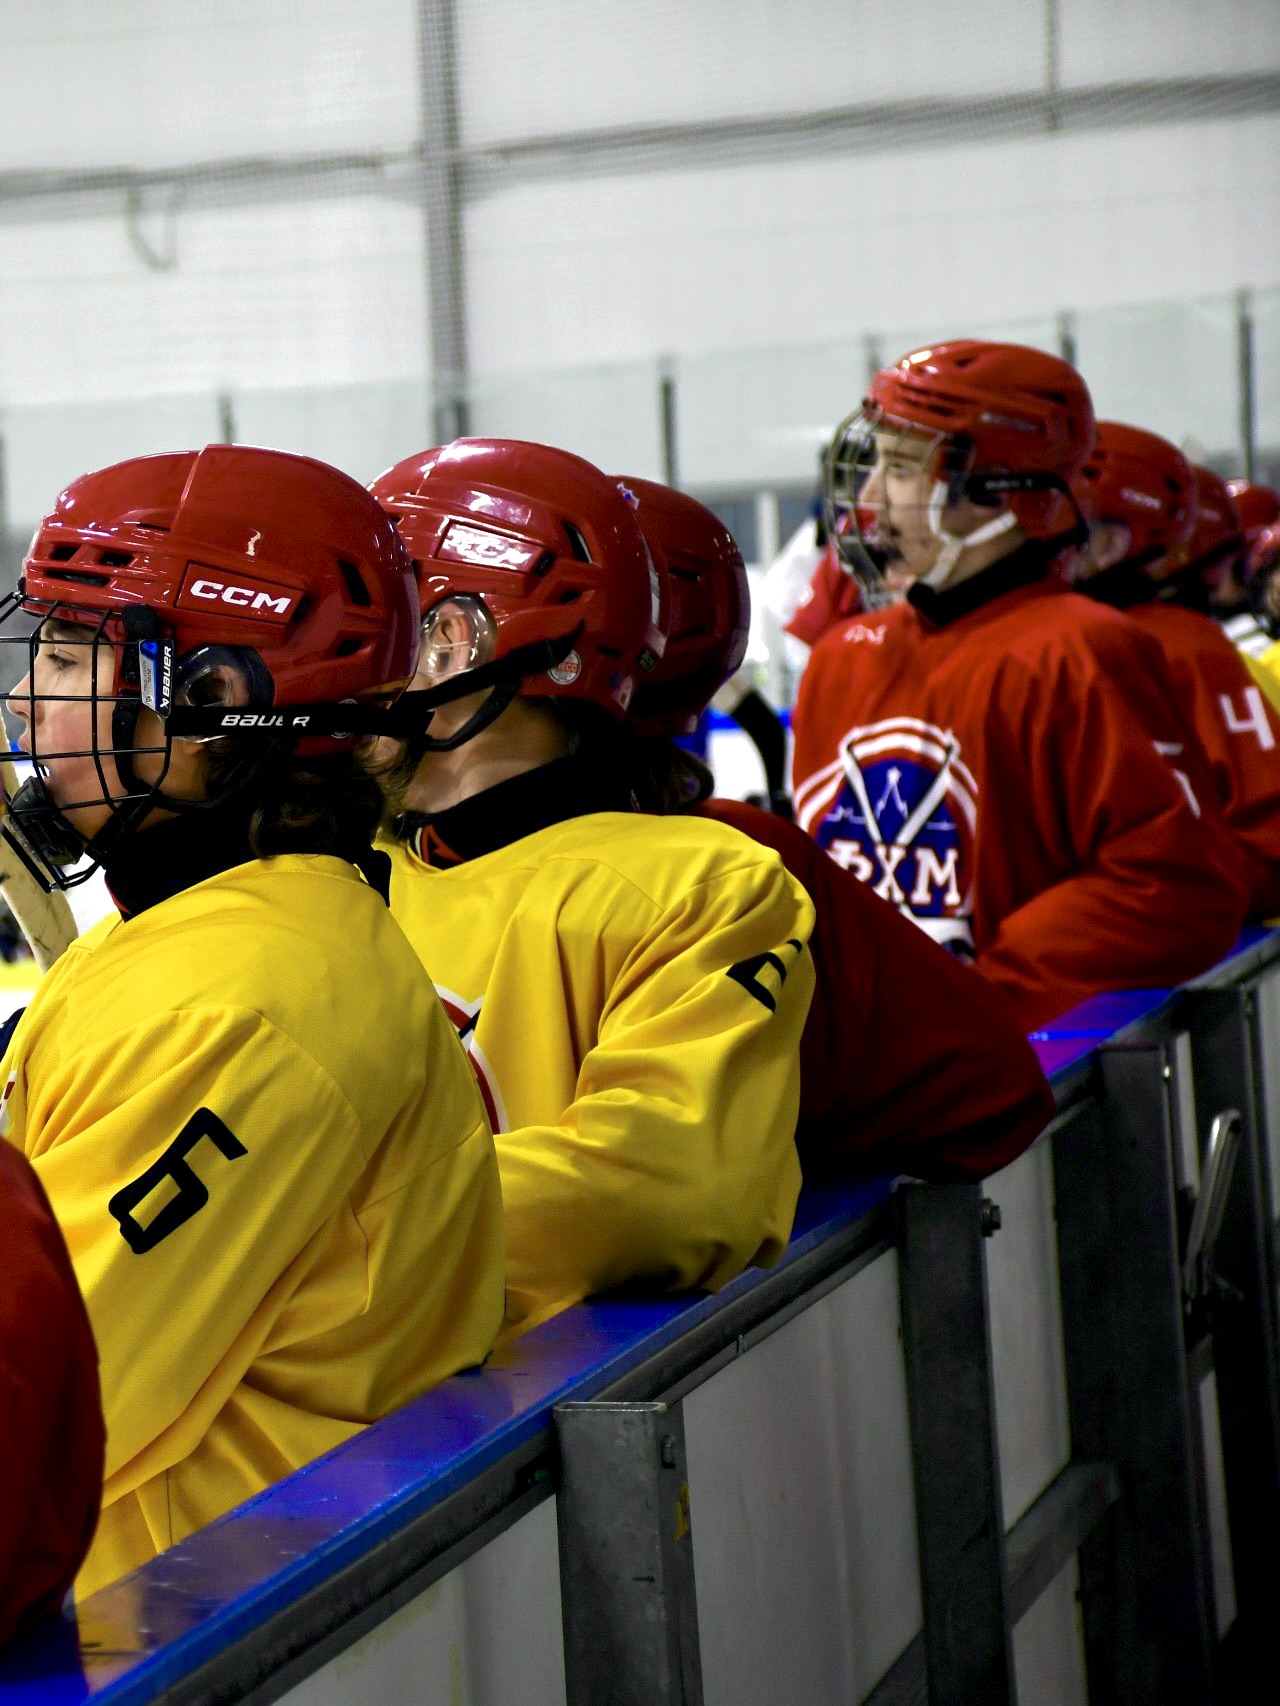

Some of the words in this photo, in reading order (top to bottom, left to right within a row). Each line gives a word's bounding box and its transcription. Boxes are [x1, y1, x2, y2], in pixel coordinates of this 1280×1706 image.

[190, 579, 292, 614] CCM
[162, 645, 172, 698] BAUER
[1220, 685, 1276, 750] 4
[108, 1106, 249, 1255] 6
